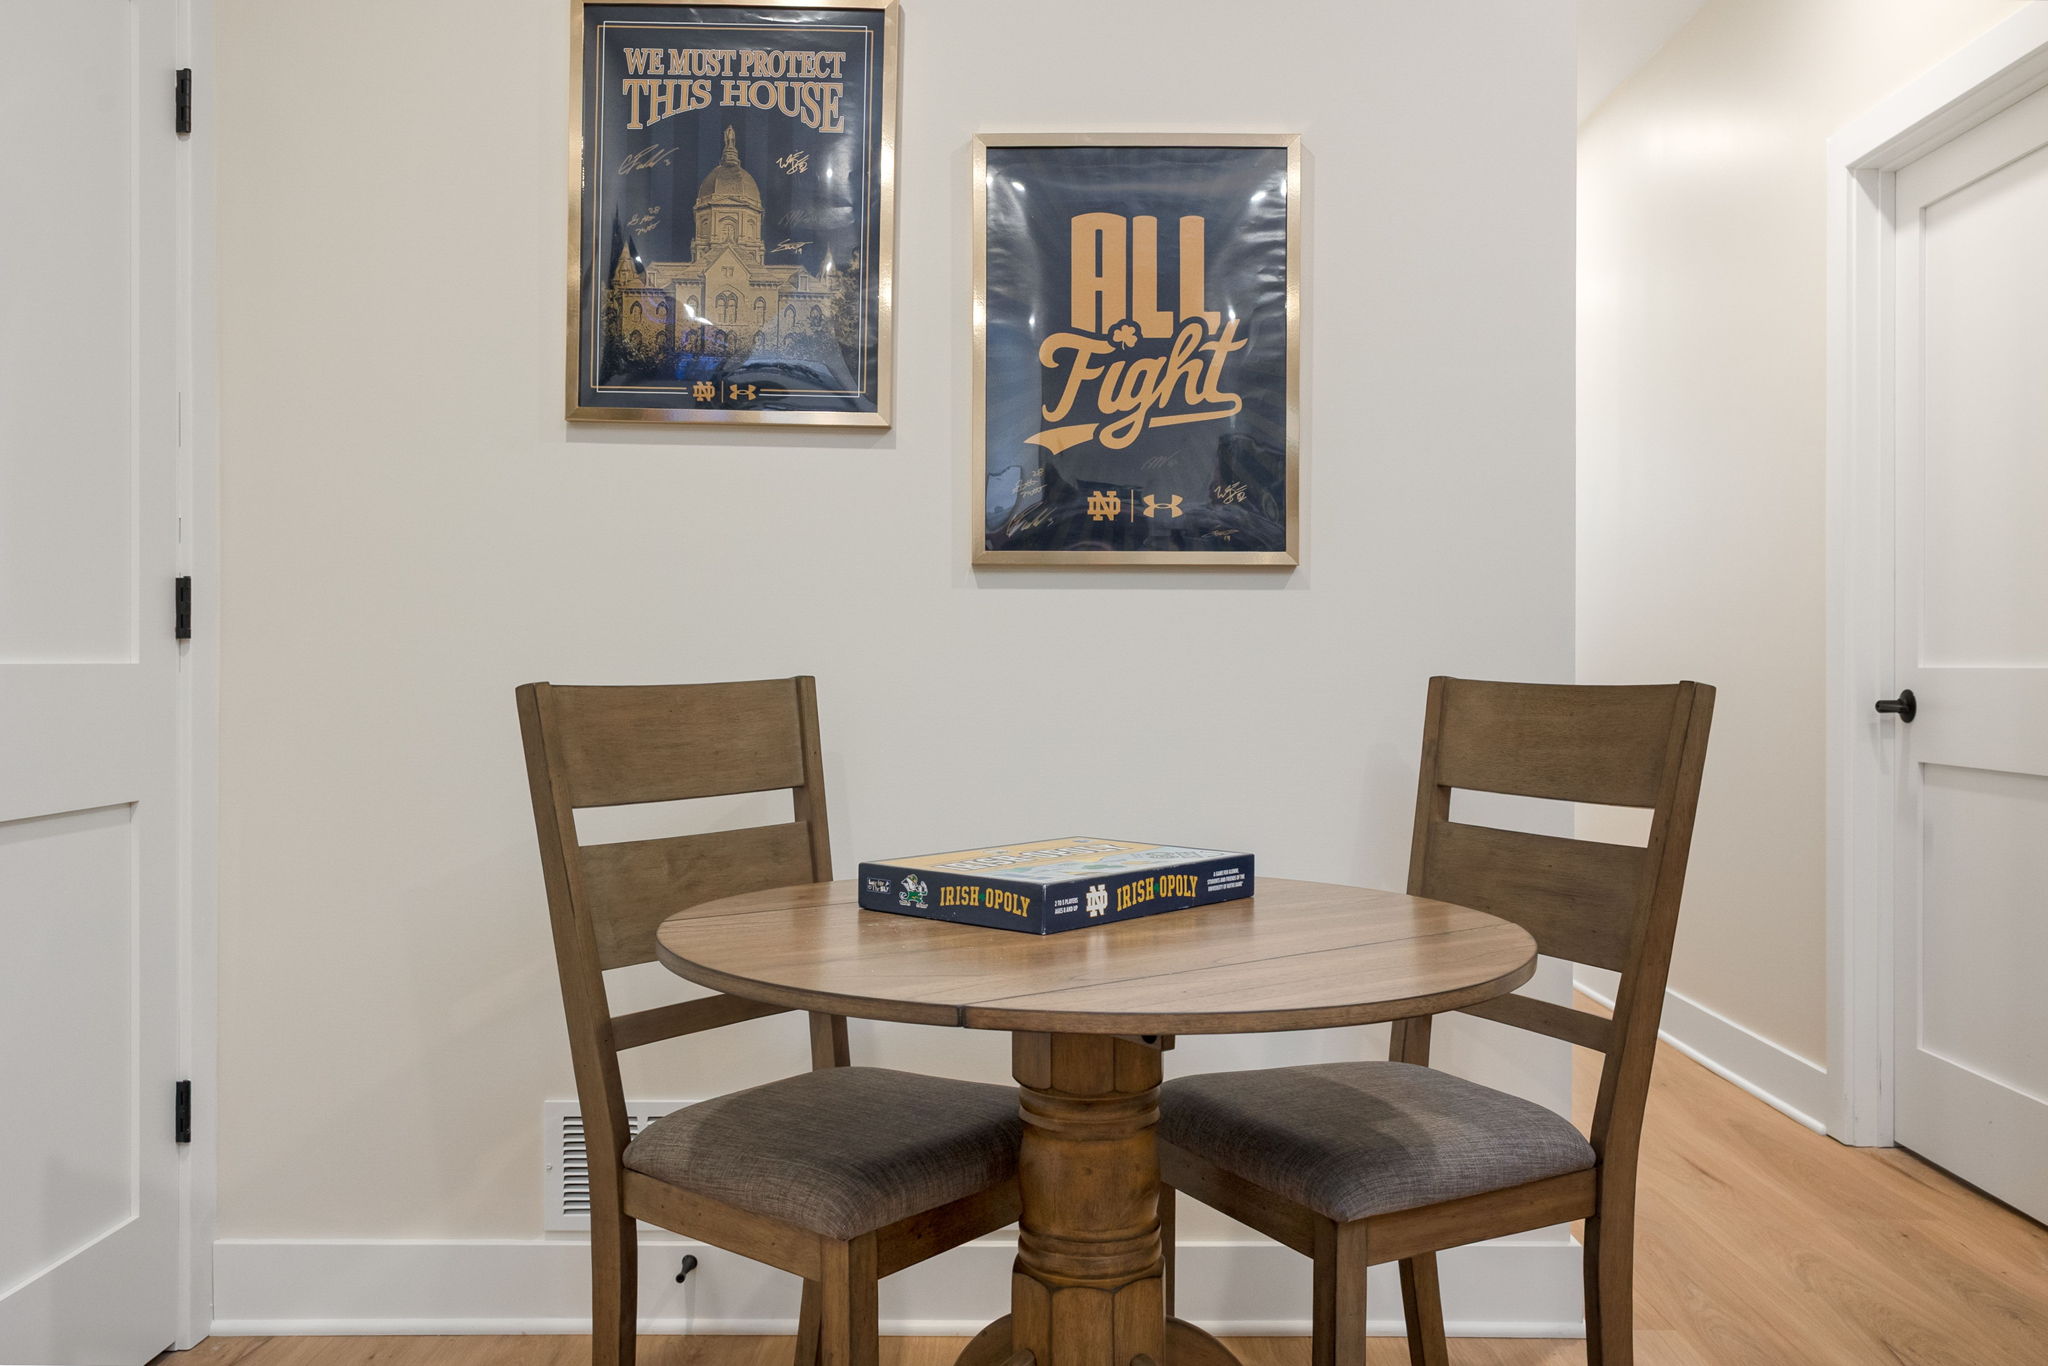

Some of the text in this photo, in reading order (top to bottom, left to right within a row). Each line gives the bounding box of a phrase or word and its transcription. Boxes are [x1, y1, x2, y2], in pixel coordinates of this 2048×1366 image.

[623, 47, 846, 79] WE MUST PROTECT
[622, 78, 845, 133] THIS HOUSE
[1070, 212, 1221, 339] ALL
[1038, 318, 1249, 450] Fight
[940, 886, 1031, 917] IRISH OPOLY
[1116, 874, 1198, 911] IRISH OPOLY
